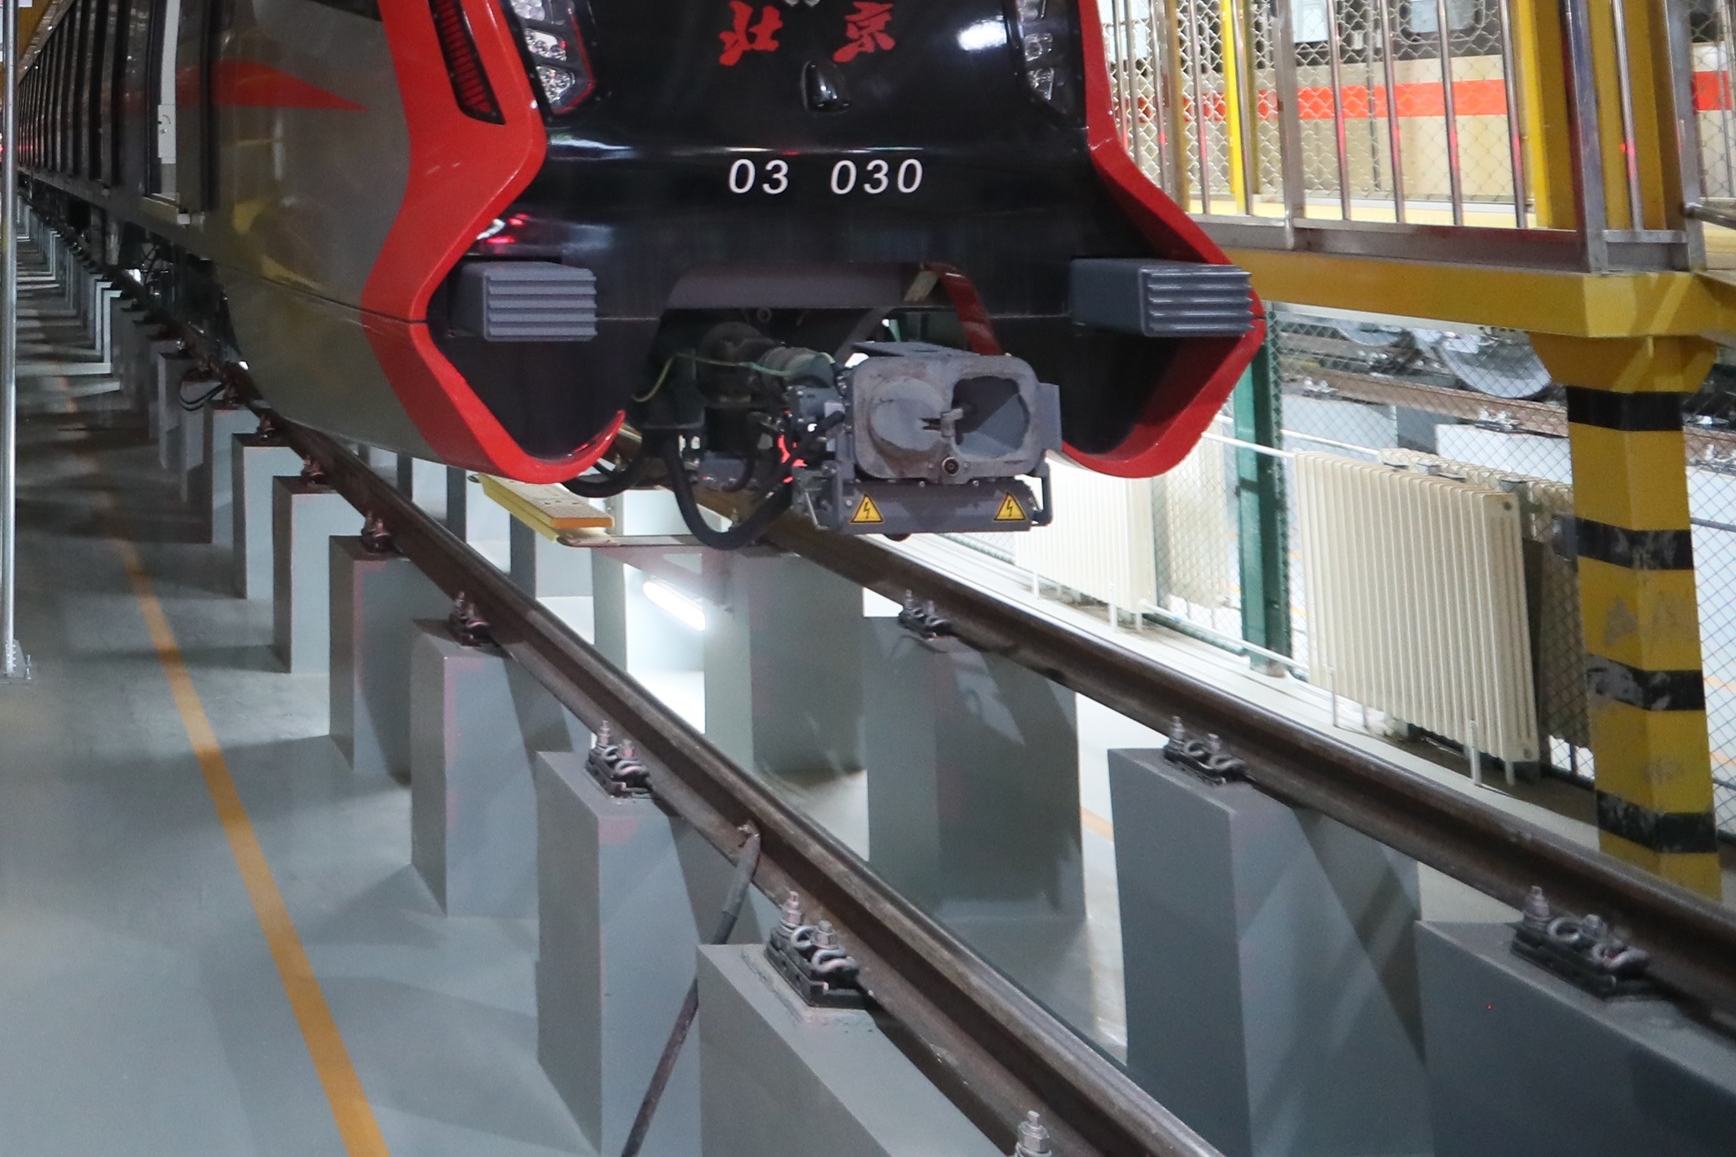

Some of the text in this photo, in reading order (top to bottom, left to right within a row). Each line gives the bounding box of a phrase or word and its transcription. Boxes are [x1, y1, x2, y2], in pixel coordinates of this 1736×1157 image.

[718, 0, 896, 66] 北京
[729, 158, 924, 195] 03 030
